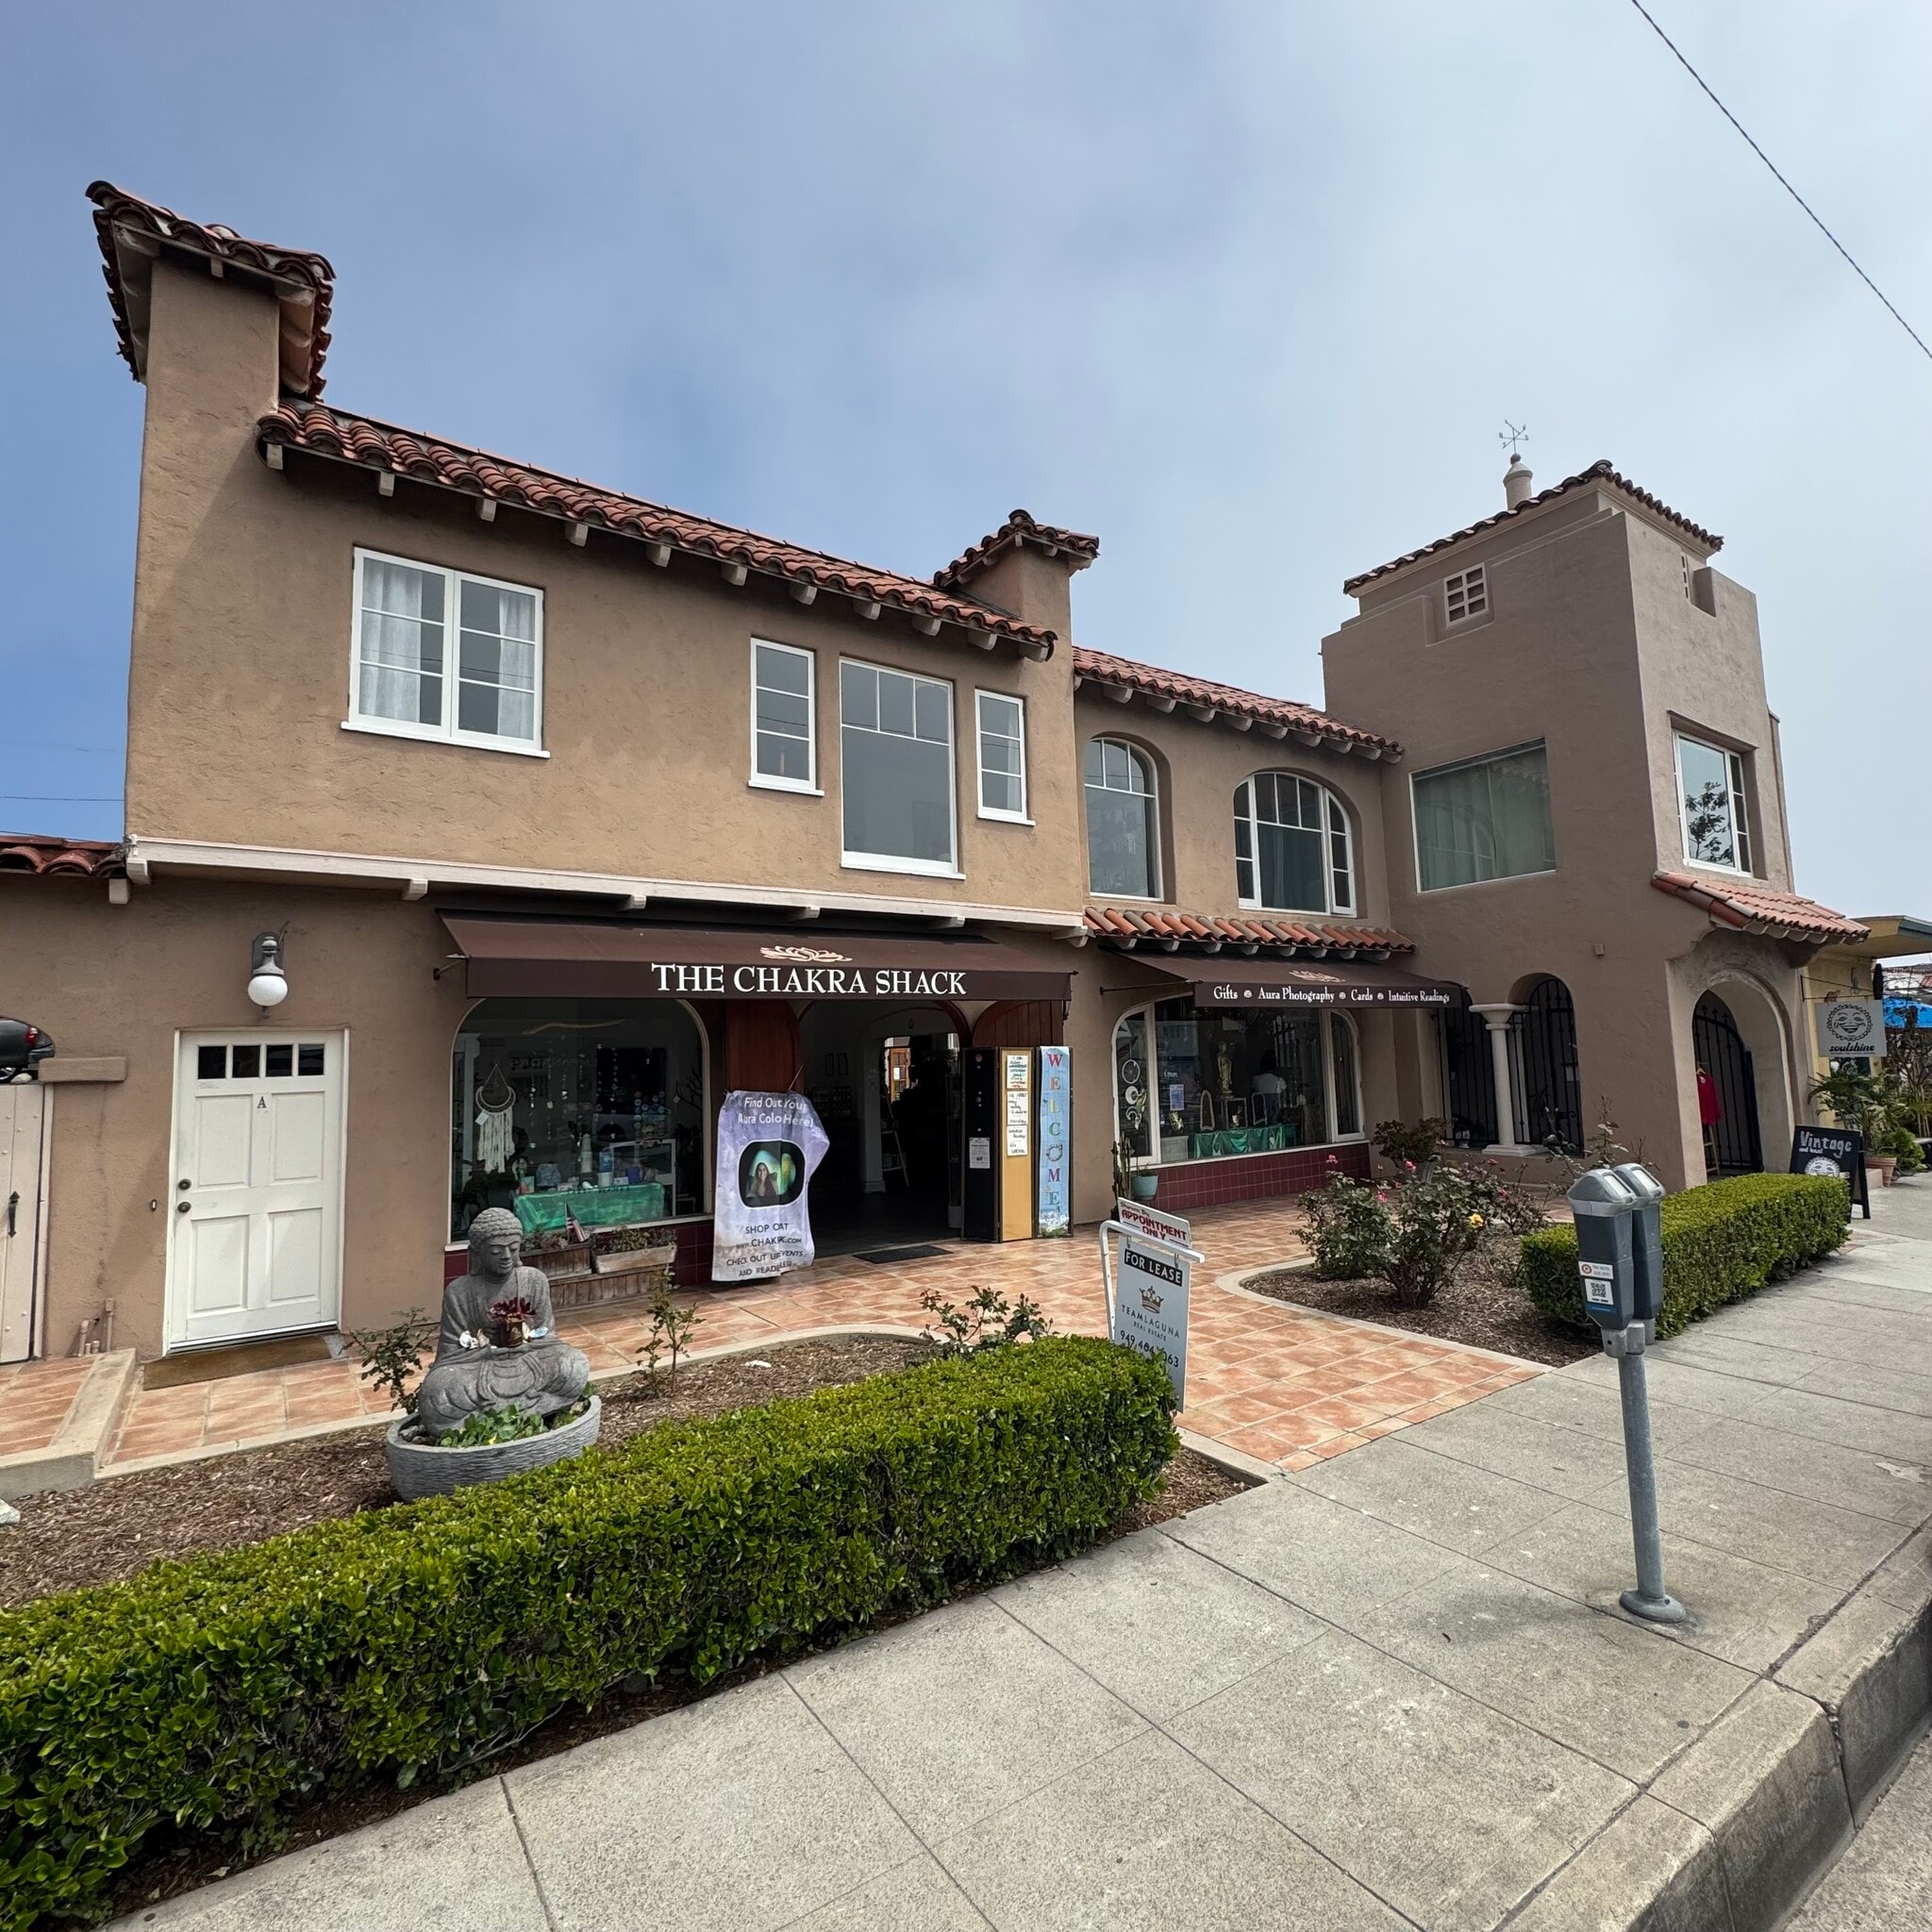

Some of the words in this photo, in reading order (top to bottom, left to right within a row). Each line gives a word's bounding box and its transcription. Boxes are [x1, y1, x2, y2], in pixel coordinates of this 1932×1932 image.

[651, 963, 724, 992] THE
[733, 966, 868, 994] CHAKRA
[875, 970, 966, 995] SHACK
[1213, 984, 1238, 999] Gifts
[1257, 987, 1280, 1000] Aura
[1282, 986, 1335, 1003] Photography
[1351, 988, 1374, 1001] Cards
[1388, 990, 1419, 1002] Intuitive
[1420, 990, 1450, 1004] Readings
[1829, 1042, 1874, 1052] soulshine
[257, 1095, 267, 1109] A
[744, 1097, 762, 1108] Find
[765, 1097, 782, 1108] Out
[738, 1113, 757, 1124] Aura
[1046, 1052, 1063, 1206] WELCOME
[1800, 1130, 1852, 1159] Vintage
[745, 1224, 770, 1235] SHOP
[1122, 1208, 1188, 1241] APPOINTMENT
[1141, 1225, 1167, 1241] ONLY
[750, 1254, 767, 1263] OUT
[1125, 1251, 1145, 1270] FOR
[1149, 1260, 1181, 1284] LEASE
[1122, 1305, 1180, 1339] TEAMLAGUNA
